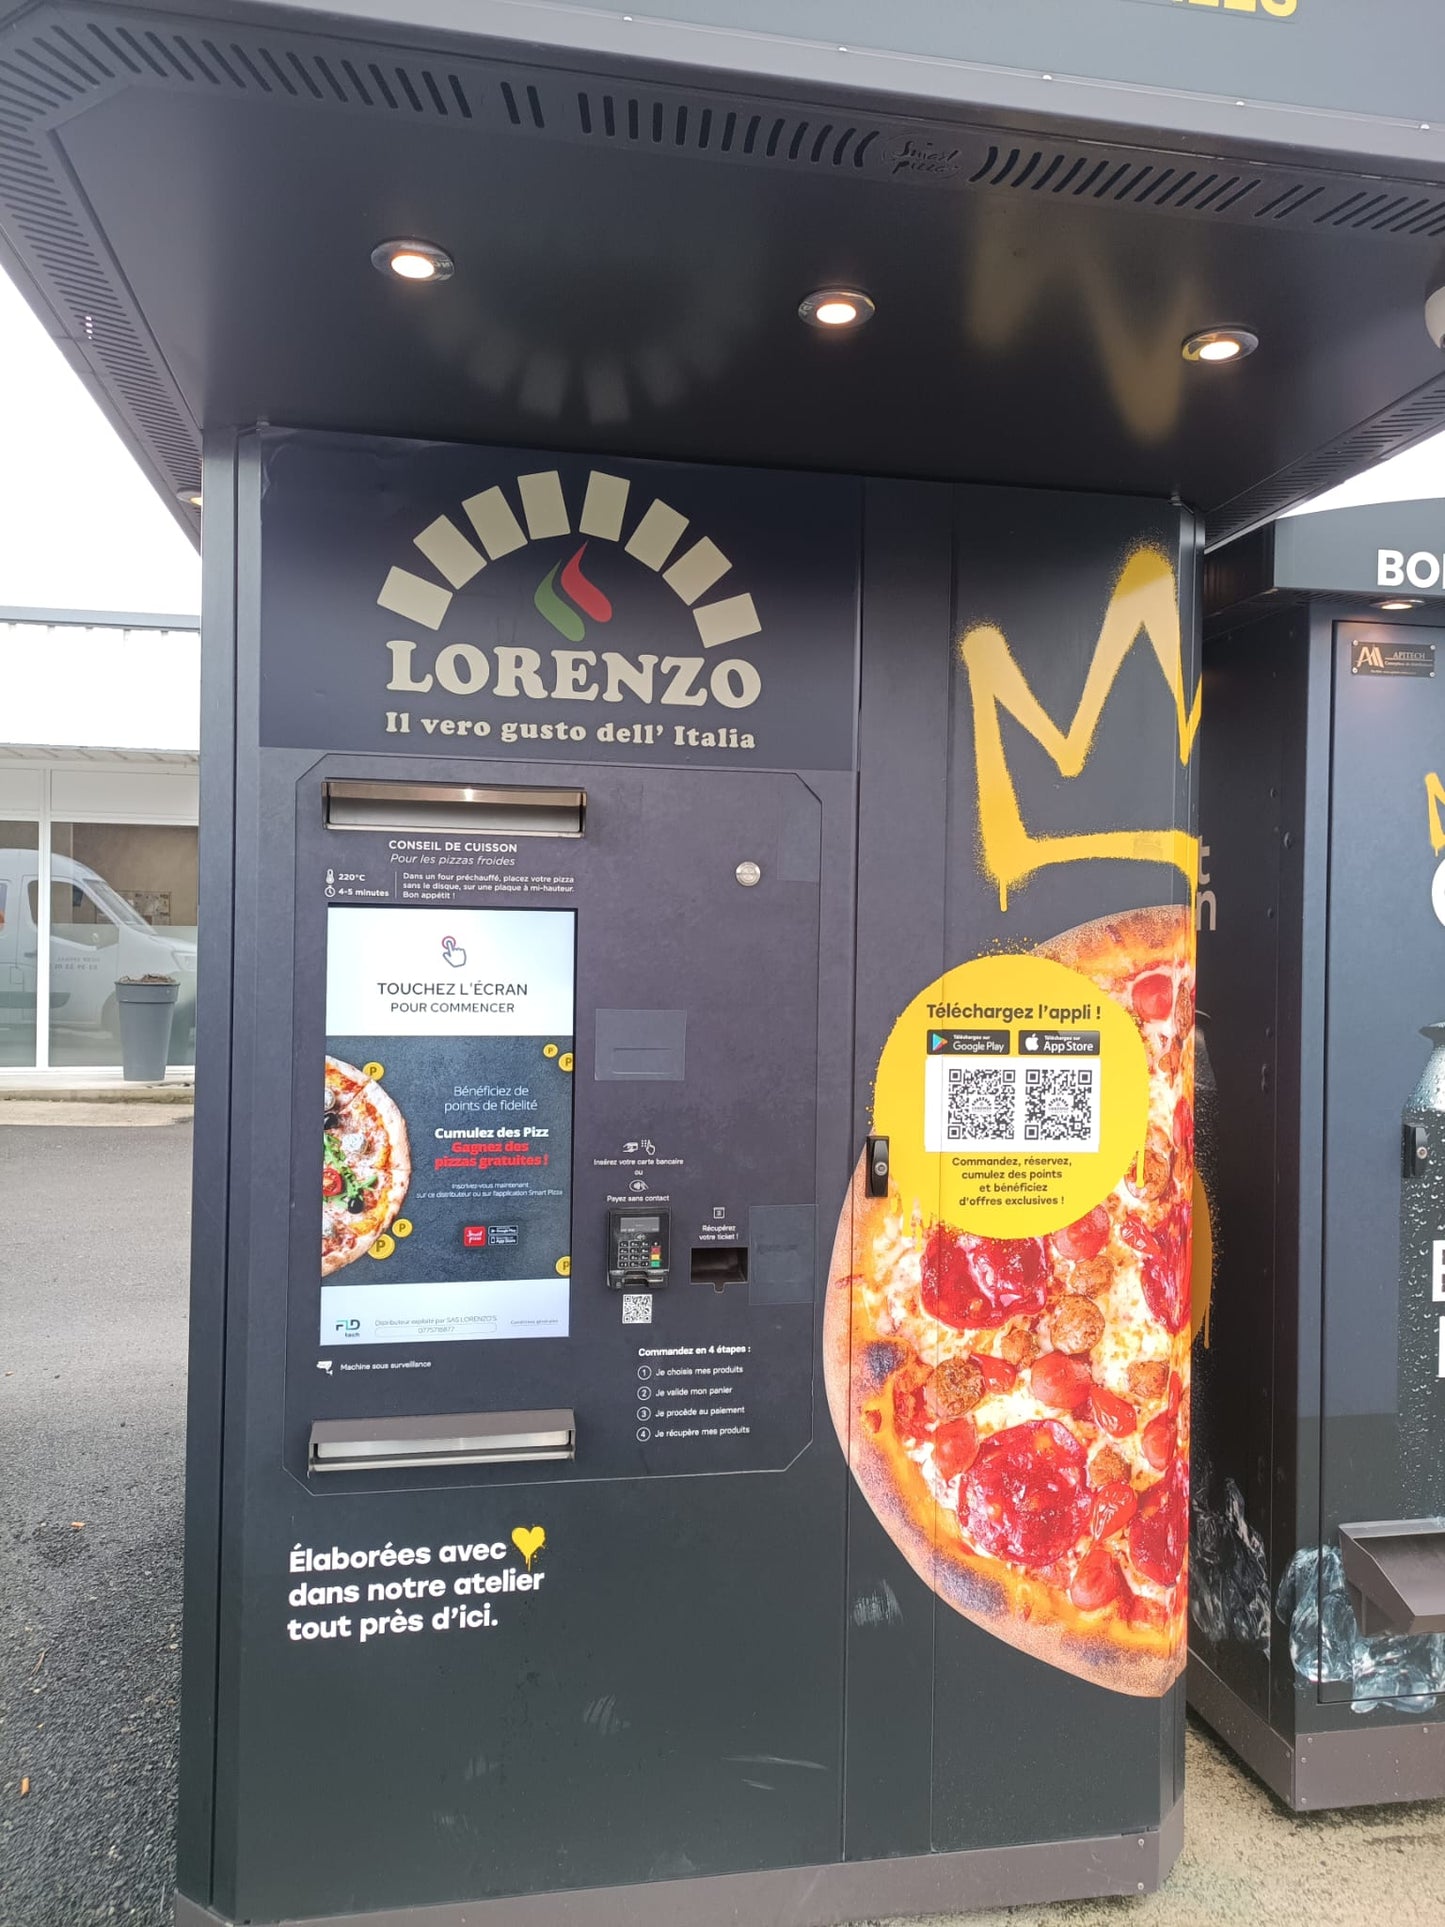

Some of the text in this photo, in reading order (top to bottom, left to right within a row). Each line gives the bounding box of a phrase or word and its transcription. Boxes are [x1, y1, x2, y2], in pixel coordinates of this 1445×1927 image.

[1377, 549, 1445, 589] BO
[386, 640, 762, 709] LORENZO
[386, 711, 756, 749] Il vero gusto dell’ Italia
[388, 840, 518, 853] CONSEIL DE CUISSON
[390, 853, 515, 867] Pour les pizzas froides
[338, 873, 366, 881] 220°C
[403, 872, 423, 880] Dans
[437, 873, 454, 881] four
[456, 873, 501, 883] préchauffé,
[503, 874, 529, 884] placez
[553, 876, 574, 885] pizza
[338, 888, 389, 897] 4-5 minutes
[432, 882, 461, 891] disque,
[494, 884, 521, 893] plaque
[523, 883, 529, 891] à
[530, 884, 575, 893] mi-hauteur.
[403, 891, 419, 899] Bon
[421, 891, 450, 900] appétit
[377, 980, 528, 996] TOUCHEZ L'ÉCRAN
[390, 1003, 515, 1013] POUR COMMENCER
[926, 1002, 1034, 1024] Téléchargez
[1038, 1003, 1092, 1024] l’appli
[953, 1040, 1005, 1053] Google Play
[1043, 1041, 1094, 1054] App Store
[453, 1086, 529, 1097] Bénéficiez de
[444, 1101, 480, 1114] points
[482, 1100, 498, 1111] de
[434, 1126, 549, 1139] Cumulez des Pizz
[451, 1141, 529, 1155] Gagnez des
[434, 1156, 477, 1172] pizzas
[479, 1155, 541, 1169] gratuites
[655, 1157, 684, 1165] bancaire
[952, 1156, 1072, 1167] Commandez, réservez,
[961, 1169, 1062, 1181] cumulez des points
[979, 1183, 1048, 1193] et bénéficiez
[606, 1195, 626, 1204] Payez
[1005, 1195, 1058, 1206] exclusives
[702, 1224, 736, 1233] Récupérez
[638, 1346, 694, 1357] Commandez
[695, 1347, 707, 1355] en
[708, 1345, 715, 1354] 4
[716, 1345, 746, 1355] étapes
[340, 1363, 371, 1371] Machine
[390, 1360, 432, 1369] surveillance
[655, 1369, 665, 1377] Je
[667, 1367, 693, 1376] choisis
[712, 1365, 744, 1376] produits
[655, 1389, 665, 1397] Je
[666, 1388, 689, 1396] valide
[690, 1388, 707, 1396] mon
[709, 1386, 733, 1396] panier
[655, 1410, 665, 1418] Je
[666, 1407, 697, 1418] procède
[699, 1408, 708, 1416] au
[710, 1406, 746, 1416] paiement
[654, 1430, 664, 1438] Je
[666, 1427, 699, 1438] récupère
[701, 1427, 718, 1435] mes
[719, 1425, 751, 1436] produits
[289, 1541, 507, 1573] Élaborées avec
[288, 1567, 545, 1607] dans notre atelier
[287, 1615, 352, 1641] tout
[359, 1608, 424, 1643] près
